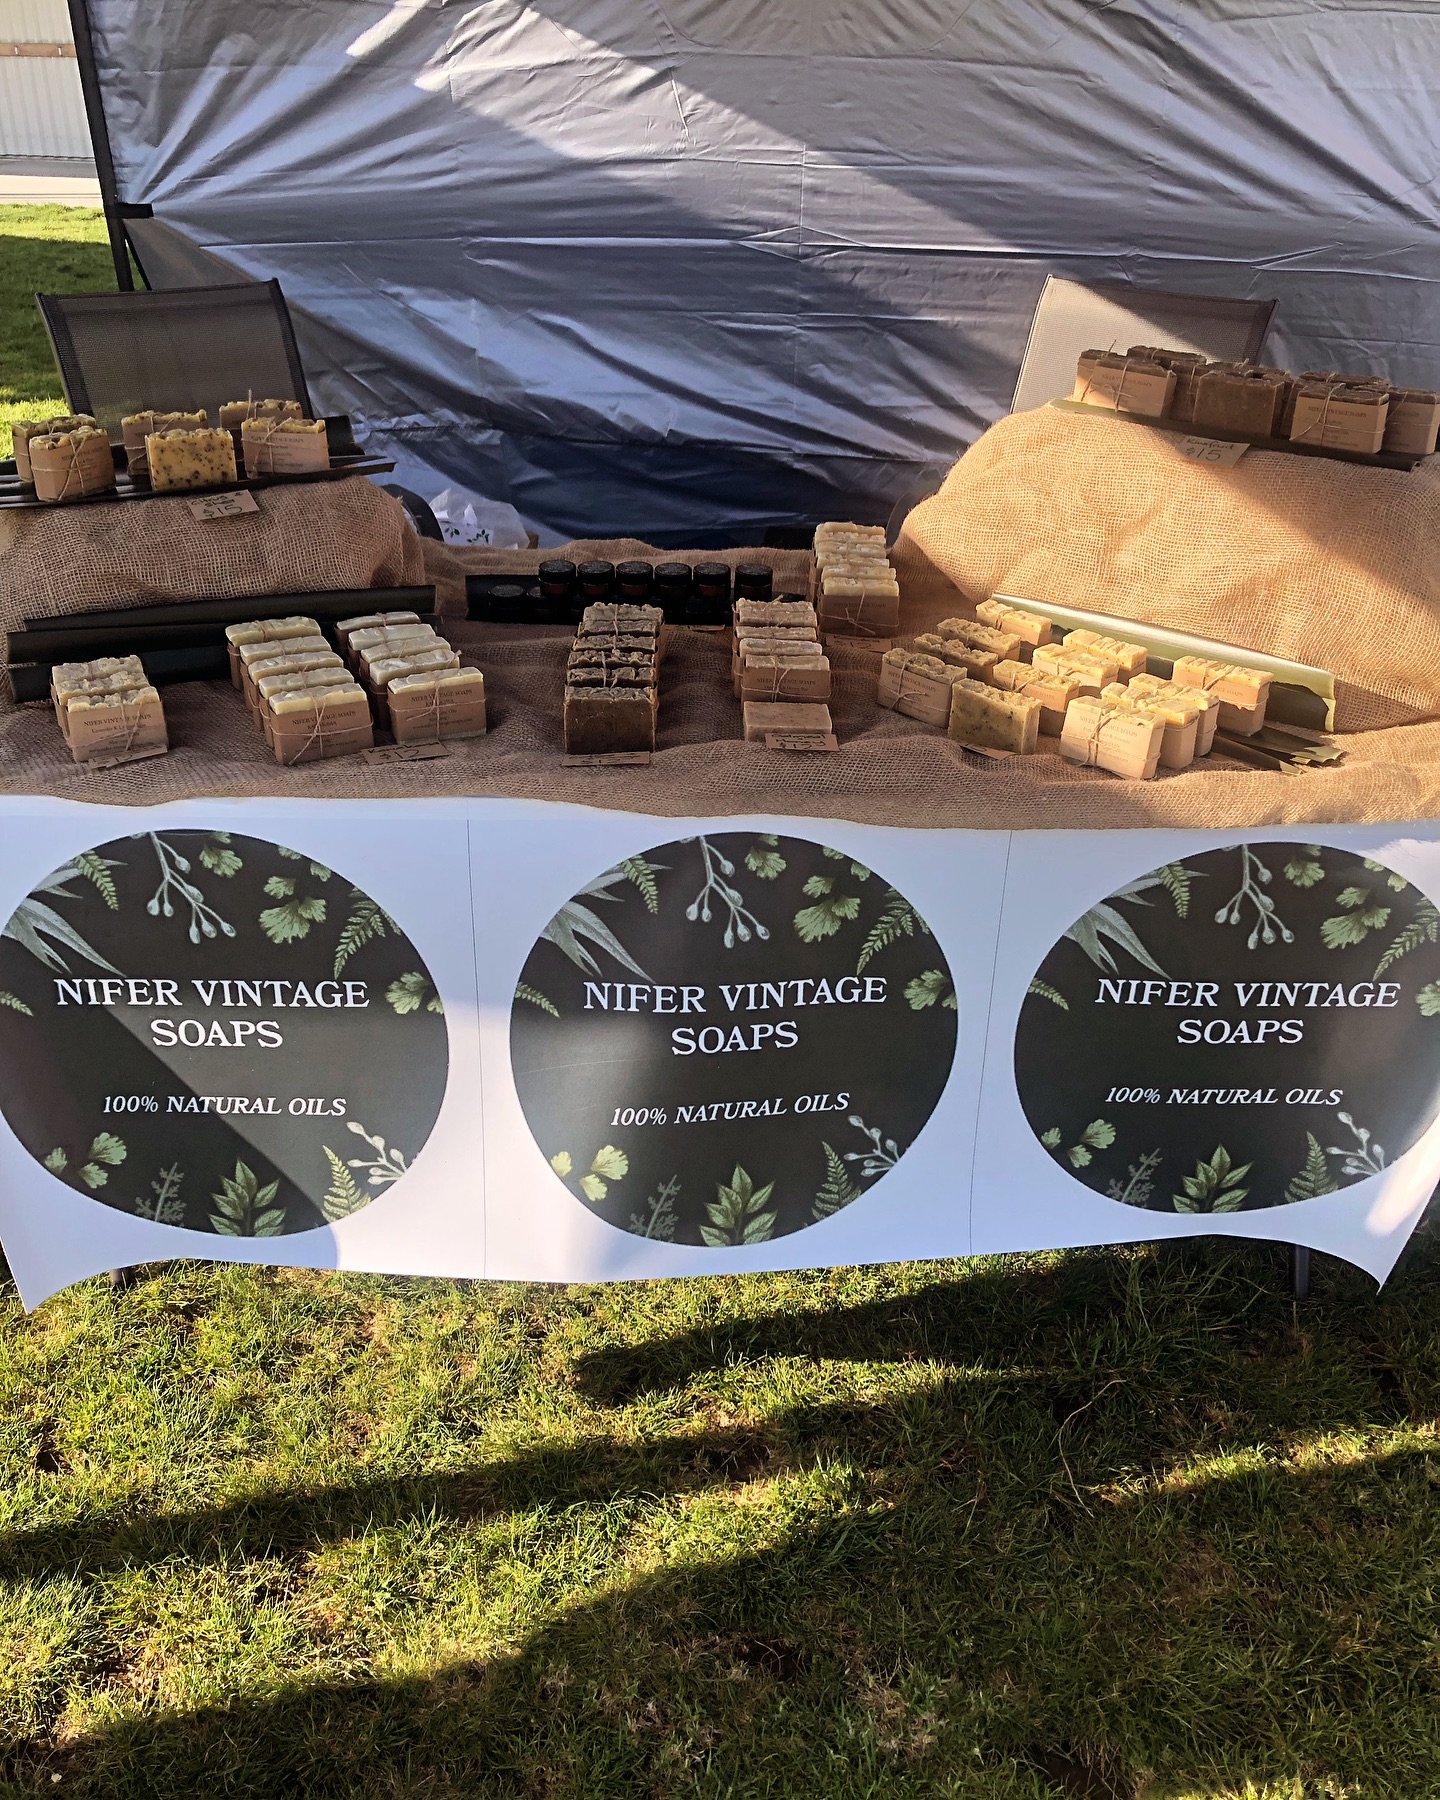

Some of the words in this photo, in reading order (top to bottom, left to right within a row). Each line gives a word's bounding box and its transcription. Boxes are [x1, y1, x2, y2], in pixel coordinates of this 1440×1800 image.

[1186, 446, 1222, 461] $15
[203, 504, 242, 518] $15
[429, 691, 454, 699] VITAGE
[311, 713, 337, 722] VITAGE
[53, 978, 183, 1007] NIFER
[191, 980, 370, 1009] VINTAGE
[583, 981, 707, 1014] NIFER
[719, 976, 888, 1012] VINTAGE
[1095, 978, 1220, 1007] NIFER
[1234, 981, 1402, 1008] VINTAGE
[151, 1019, 284, 1049] SOAPS
[671, 1020, 799, 1056] SOAPS
[1177, 1019, 1304, 1045] SOAPS
[103, 1095, 159, 1113] 100%
[166, 1096, 282, 1115] NATURAL
[289, 1097, 347, 1117] OILS
[610, 1107, 668, 1126] 100%
[673, 1097, 788, 1125] NATURAL
[794, 1092, 851, 1114] OILS
[1105, 1086, 1161, 1104] 100%
[1166, 1087, 1279, 1105] NATURAL
[1286, 1088, 1344, 1106] OILS
